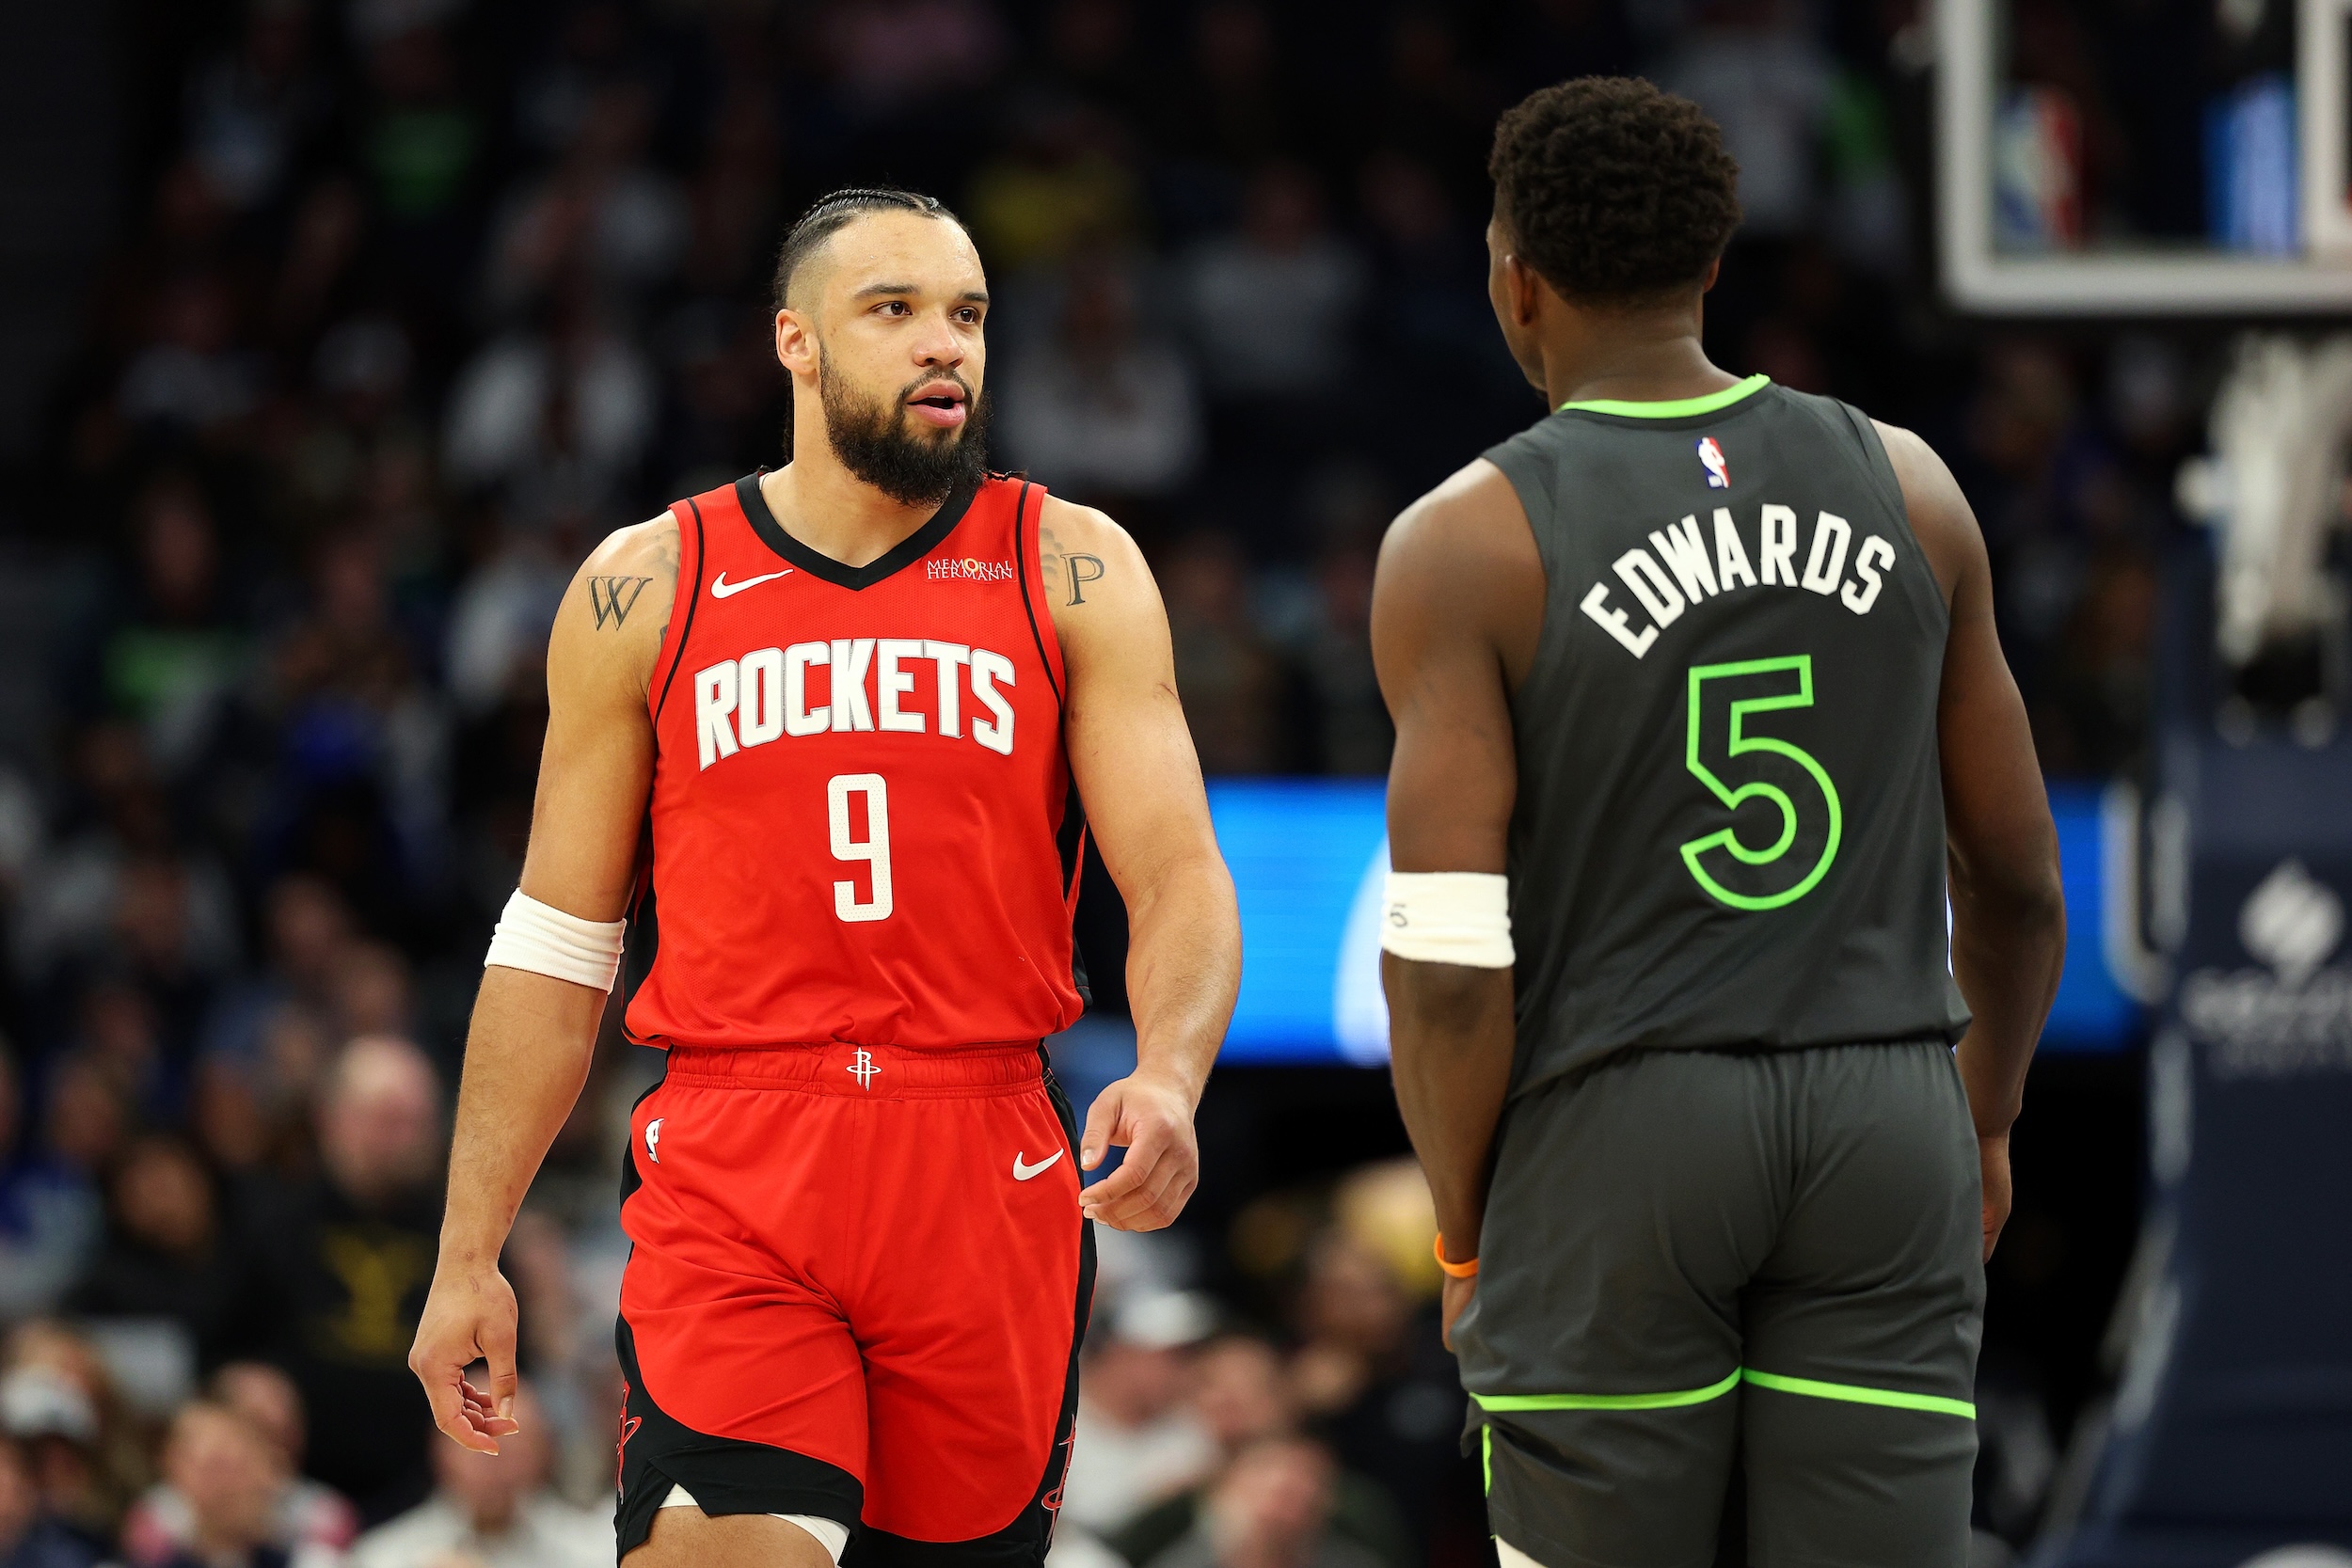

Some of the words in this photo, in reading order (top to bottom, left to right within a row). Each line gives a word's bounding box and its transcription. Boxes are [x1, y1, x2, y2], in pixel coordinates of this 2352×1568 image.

[586, 576, 654, 632] W
[927, 558, 1013, 572] MEMORIAL
[927, 566, 1013, 581] HERMANN
[1060, 552, 1105, 607] P
[1580, 503, 1896, 658] EDWARDS
[694, 639, 1015, 771] ROCKETS
[1680, 654, 1842, 911] 5
[827, 773, 894, 923] 9
